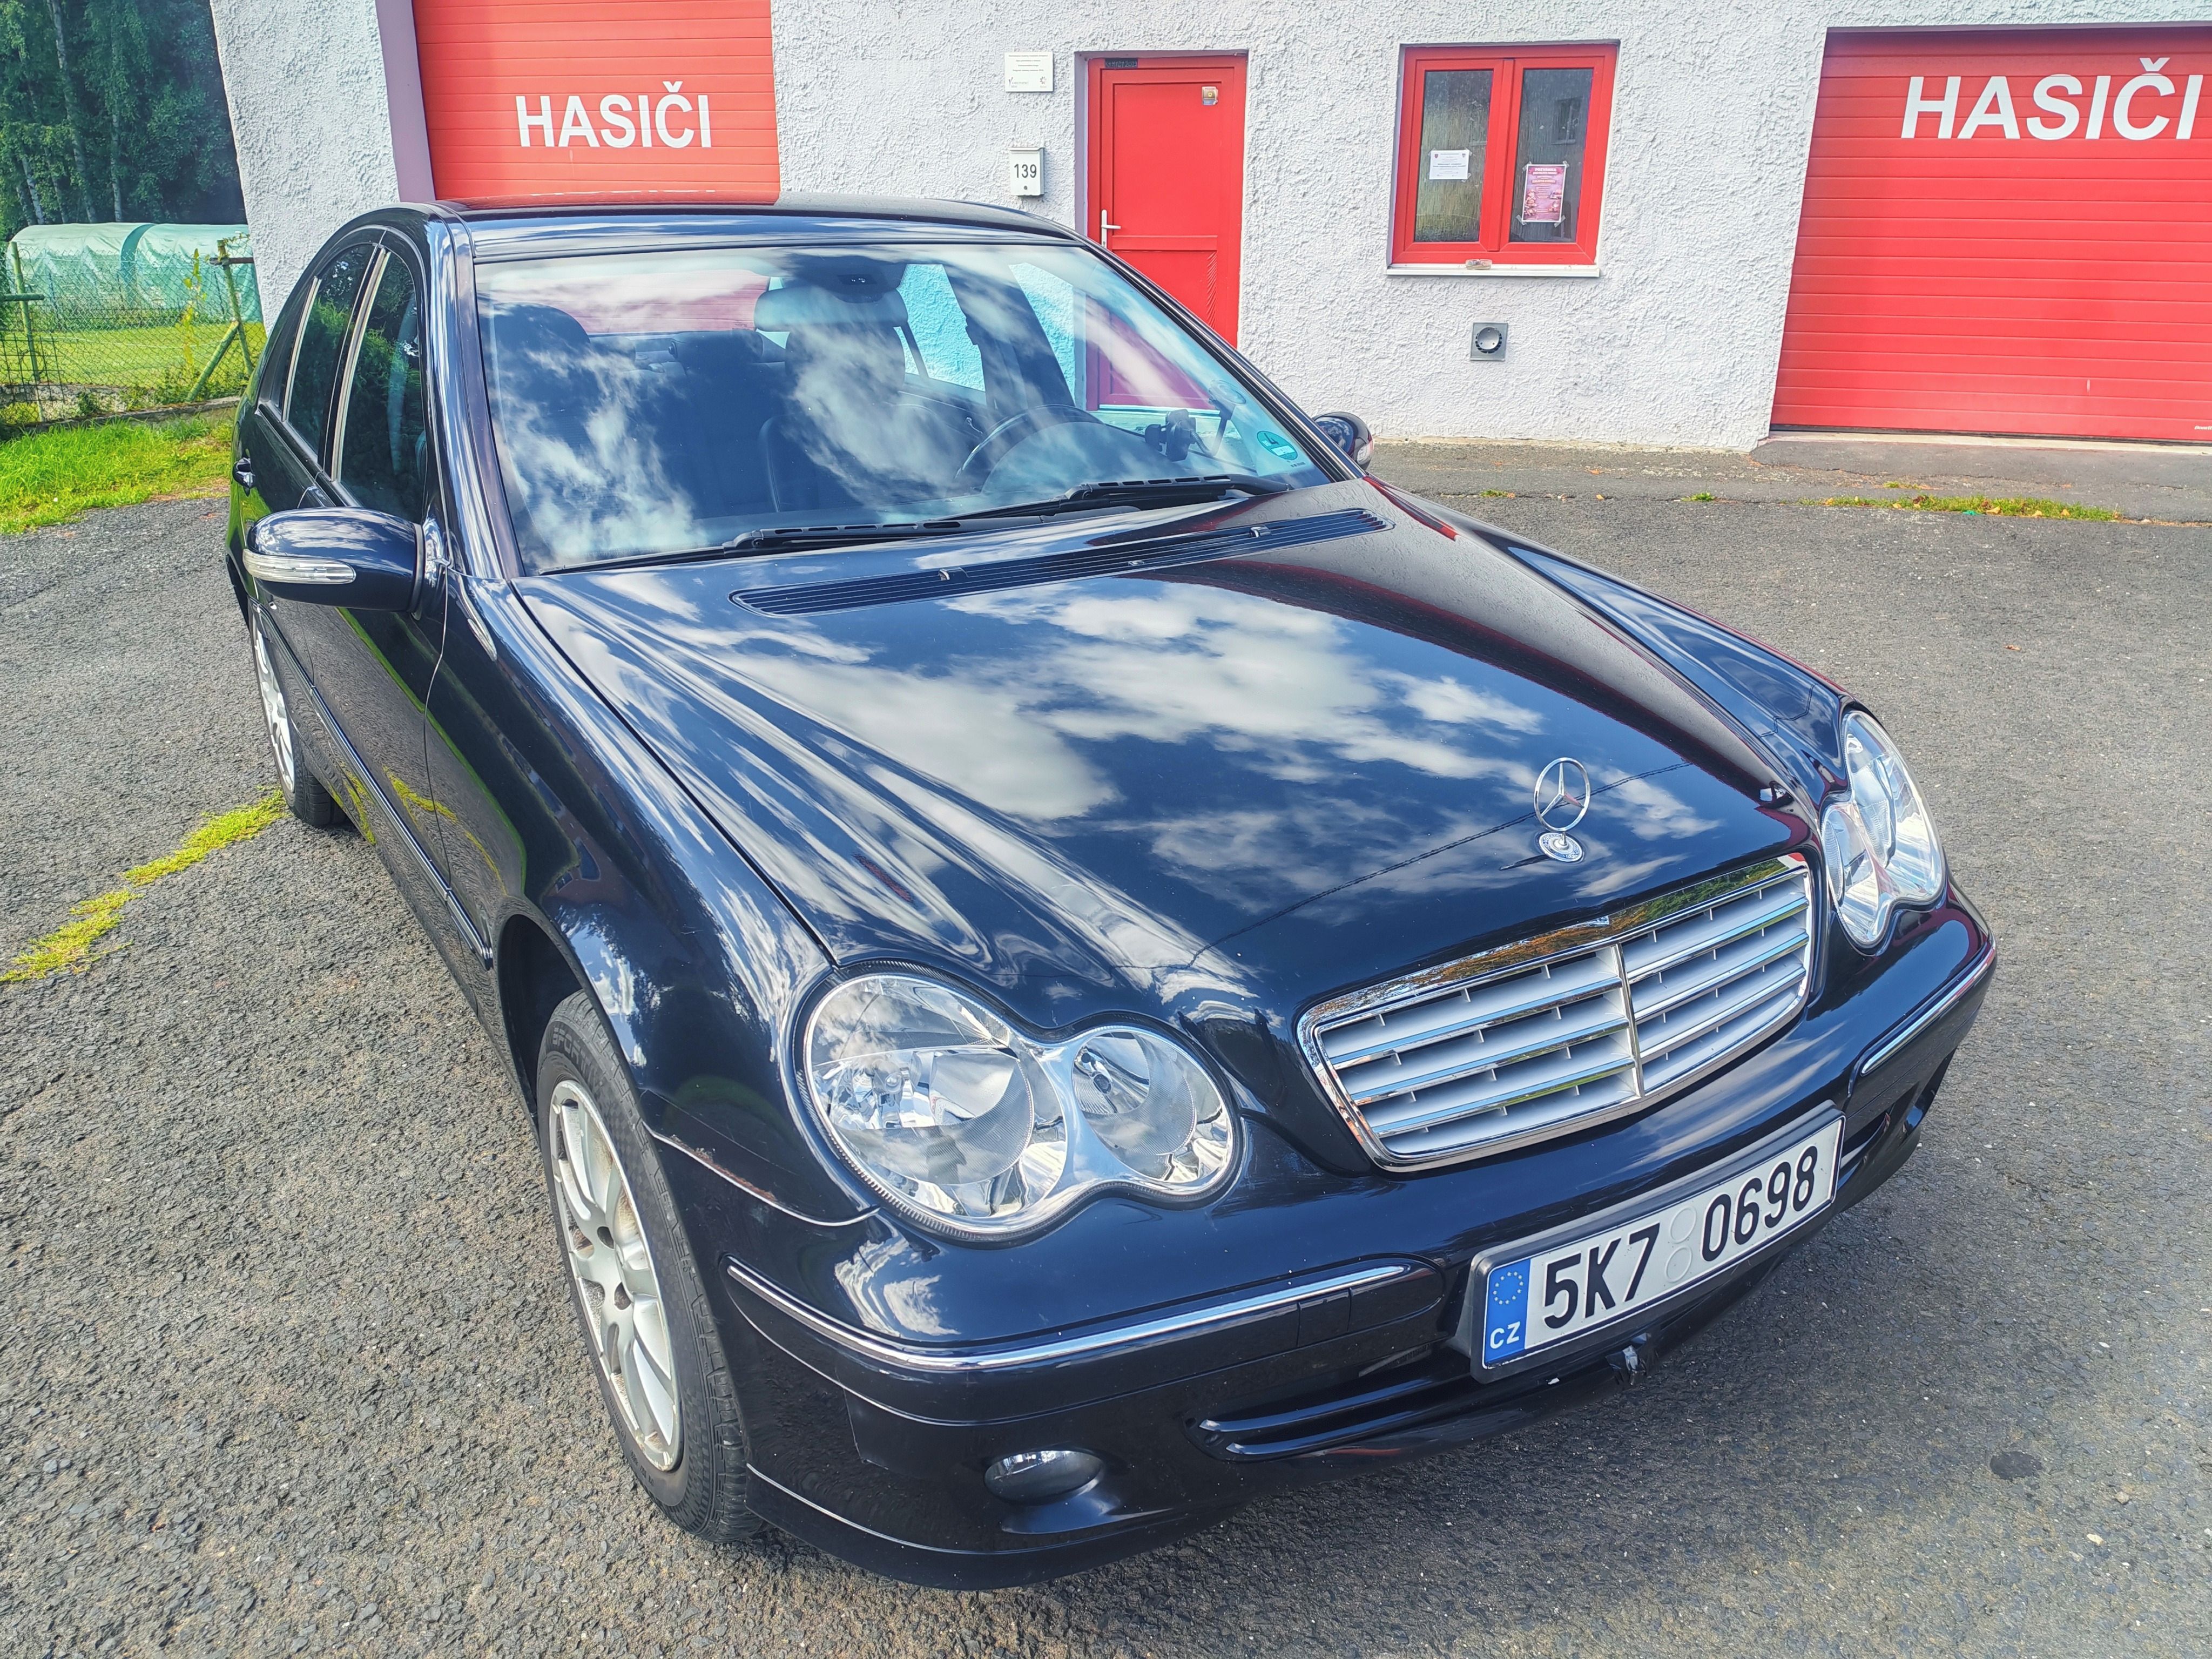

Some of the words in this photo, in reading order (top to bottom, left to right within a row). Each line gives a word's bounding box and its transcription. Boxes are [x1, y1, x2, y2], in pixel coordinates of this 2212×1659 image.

[516, 81, 712, 148] HASIČI
[1900, 57, 2204, 140] HASIČI
[1014, 164, 1037, 178] 139
[1263, 433, 1280, 446] 4
[1543, 1223, 1660, 1330] 5K7
[1701, 1145, 1818, 1262] 0698
[1489, 1321, 1521, 1349] CZ
